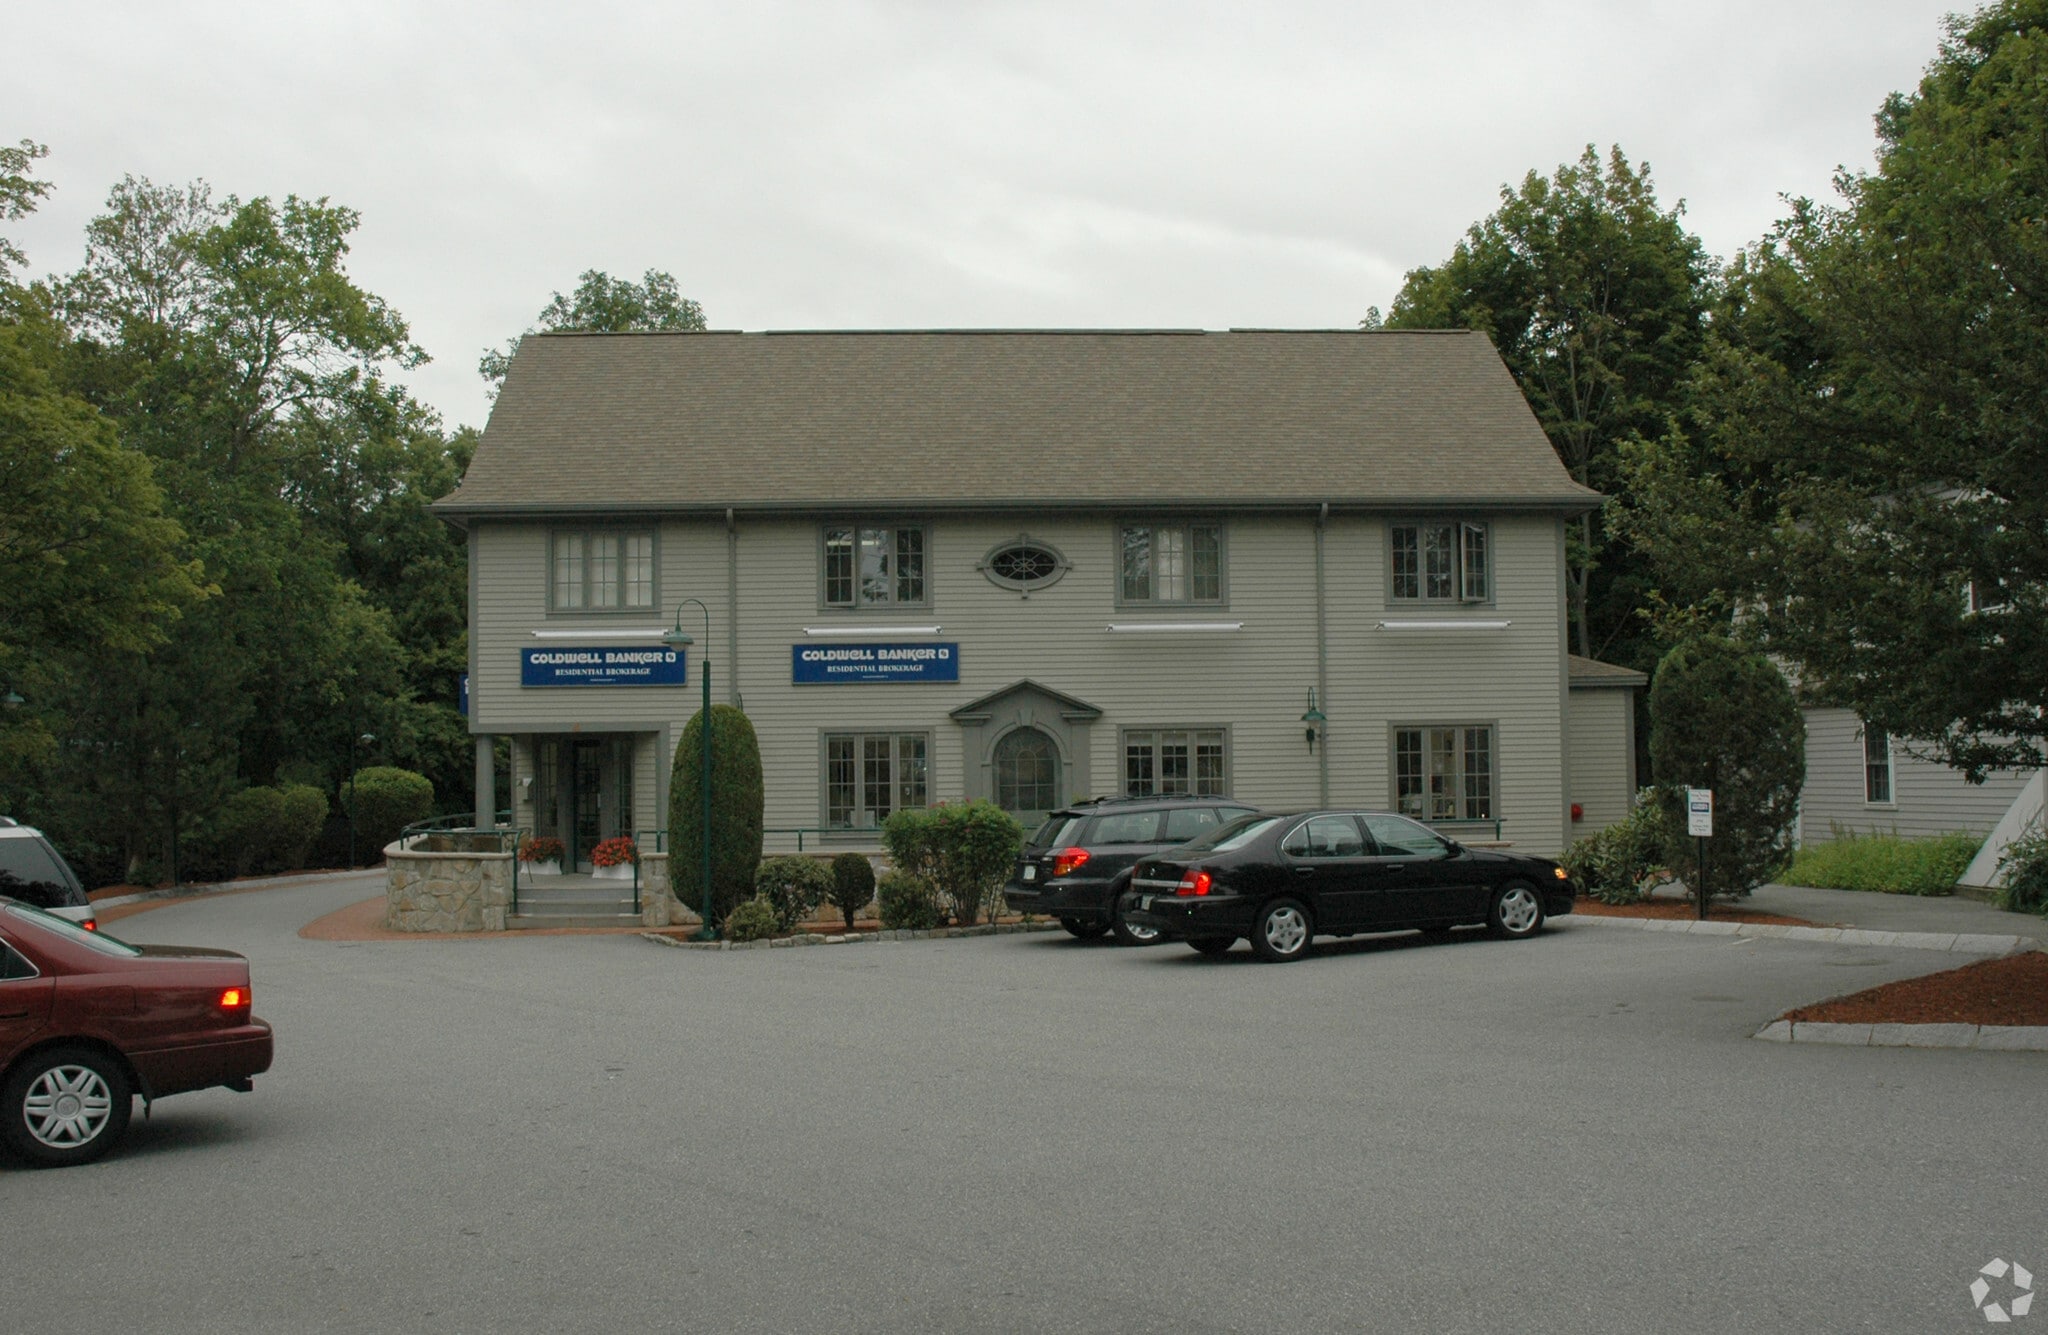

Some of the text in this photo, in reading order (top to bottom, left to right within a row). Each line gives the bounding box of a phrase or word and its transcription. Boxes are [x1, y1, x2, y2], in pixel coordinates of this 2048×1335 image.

[530, 652, 663, 664] COLDWELL BANKER
[801, 649, 936, 661] COLDWELL BANKER
[555, 668, 651, 676] RESIDENTIAL BROKERAGE
[827, 664, 924, 673] RESIDENTIAL BROKERAGE
